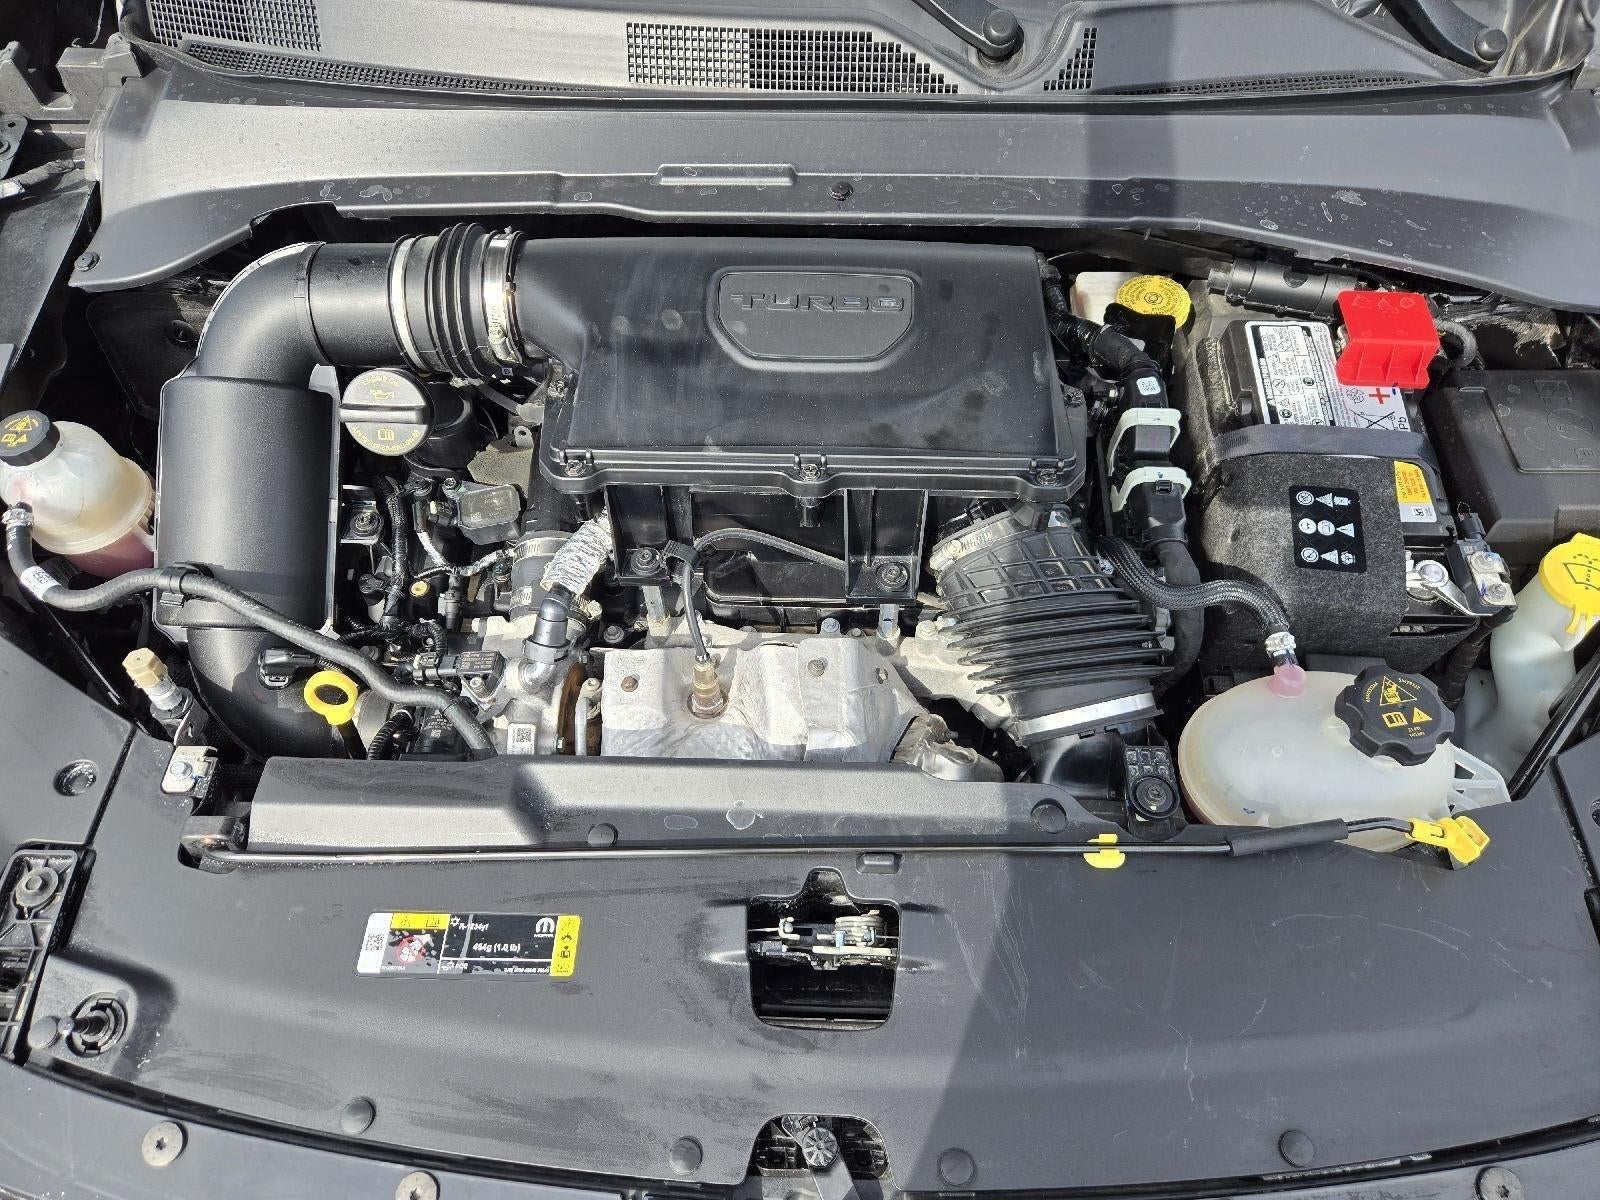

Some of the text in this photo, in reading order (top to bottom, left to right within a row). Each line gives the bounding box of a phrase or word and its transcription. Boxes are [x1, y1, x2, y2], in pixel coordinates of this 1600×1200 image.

[730, 294, 904, 312] TURBO
[1397, 416, 1409, 430] Pb
[472, 942, 492, 953] 454g
